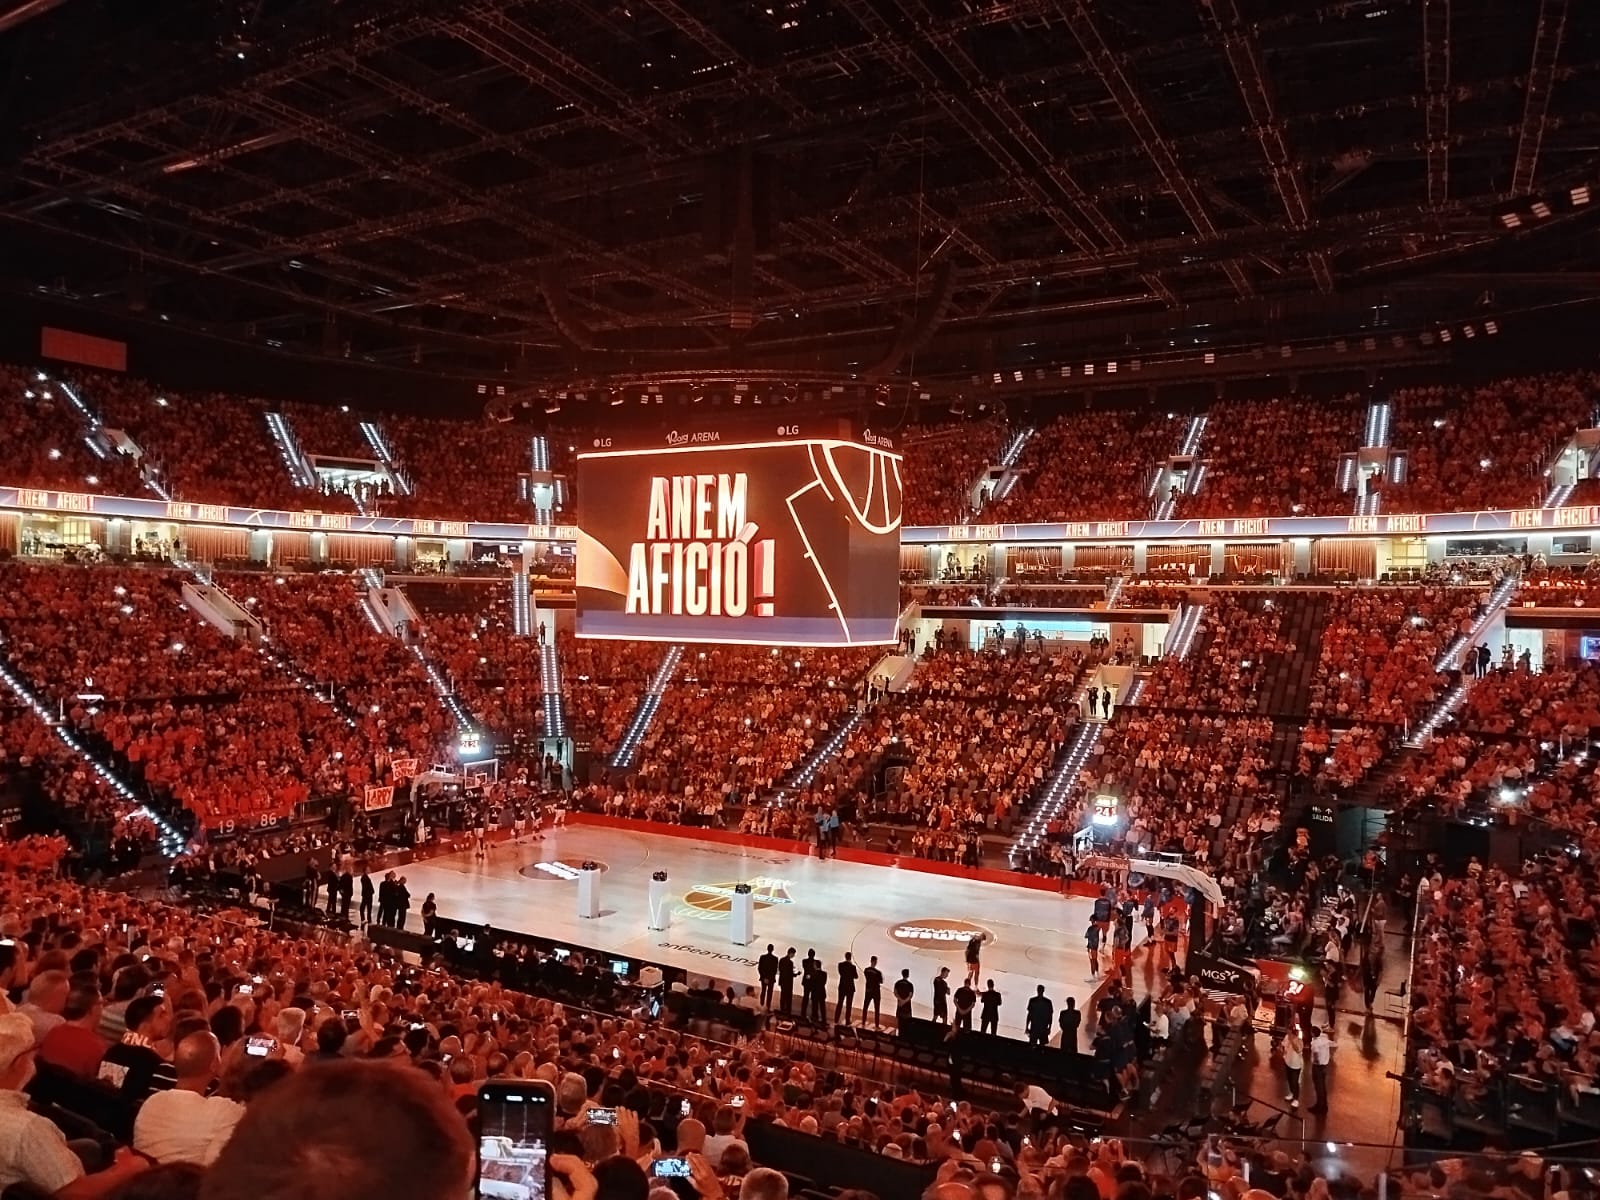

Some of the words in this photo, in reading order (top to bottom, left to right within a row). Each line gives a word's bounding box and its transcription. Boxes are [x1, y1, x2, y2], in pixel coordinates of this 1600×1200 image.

[786, 425, 799, 435] LG
[600, 438, 612, 448] LG
[691, 432, 720, 442] ARENA
[647, 473, 748, 540] ANEM
[1348, 517, 1377, 532] ANEM
[626, 522, 775, 617] AFICIÓ!
[260, 813, 277, 827] 86
[1312, 814, 1333, 822] SALIDA
[219, 819, 235, 834] 19
[1201, 968, 1226, 981] MGS
